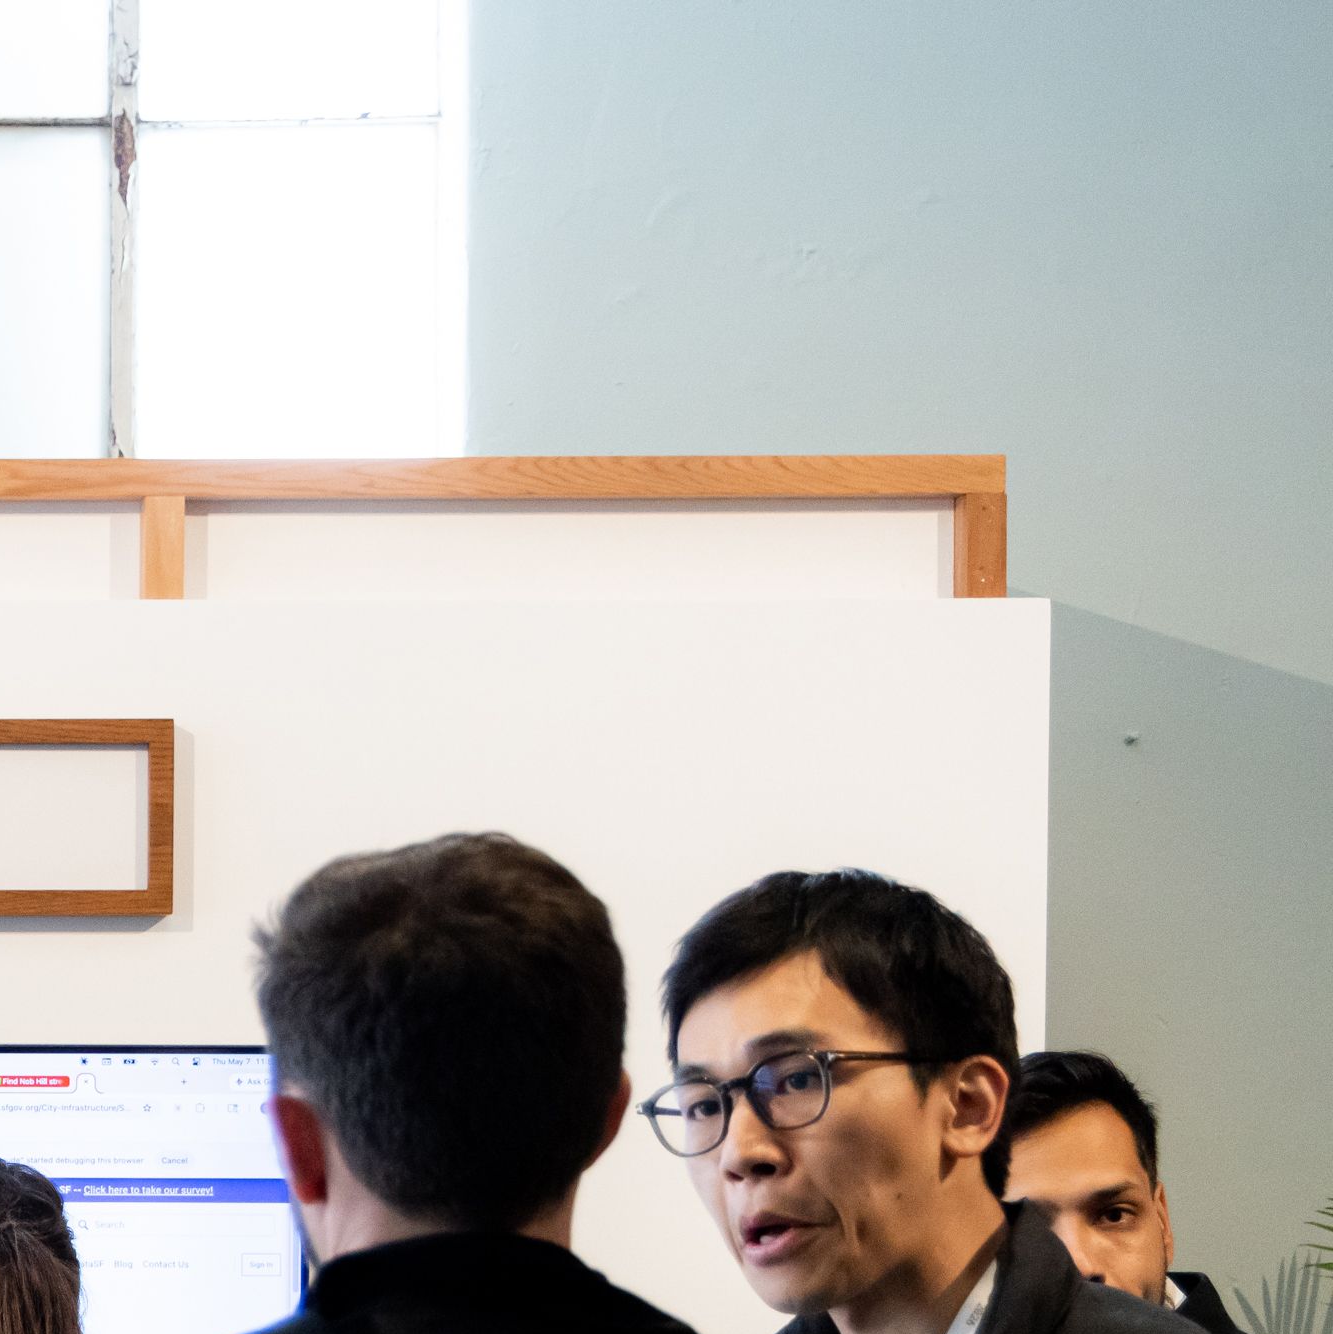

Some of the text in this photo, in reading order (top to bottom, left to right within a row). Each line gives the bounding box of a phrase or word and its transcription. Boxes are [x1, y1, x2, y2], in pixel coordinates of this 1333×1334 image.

[212, 1057, 227, 1065] Thu
[227, 1057, 245, 1066] May
[246, 1079, 262, 1087] Ask
[26, 1157, 55, 1165] started
[55, 1157, 96, 1167] debugging
[96, 1157, 114, 1165] this
[114, 1157, 145, 1165] browser
[161, 1157, 189, 1165] Cancel
[83, 1186, 106, 1195] Click
[107, 1186, 129, 1195] here
[129, 1186, 140, 1195] to
[141, 1186, 163, 1195] take
[163, 1187, 180, 1195] our
[180, 1186, 214, 1195] survey!
[94, 1220, 125, 1228] Search
[113, 1260, 133, 1270] Blog
[142, 1260, 176, 1268] Contact
[178, 1260, 190, 1268] Us
